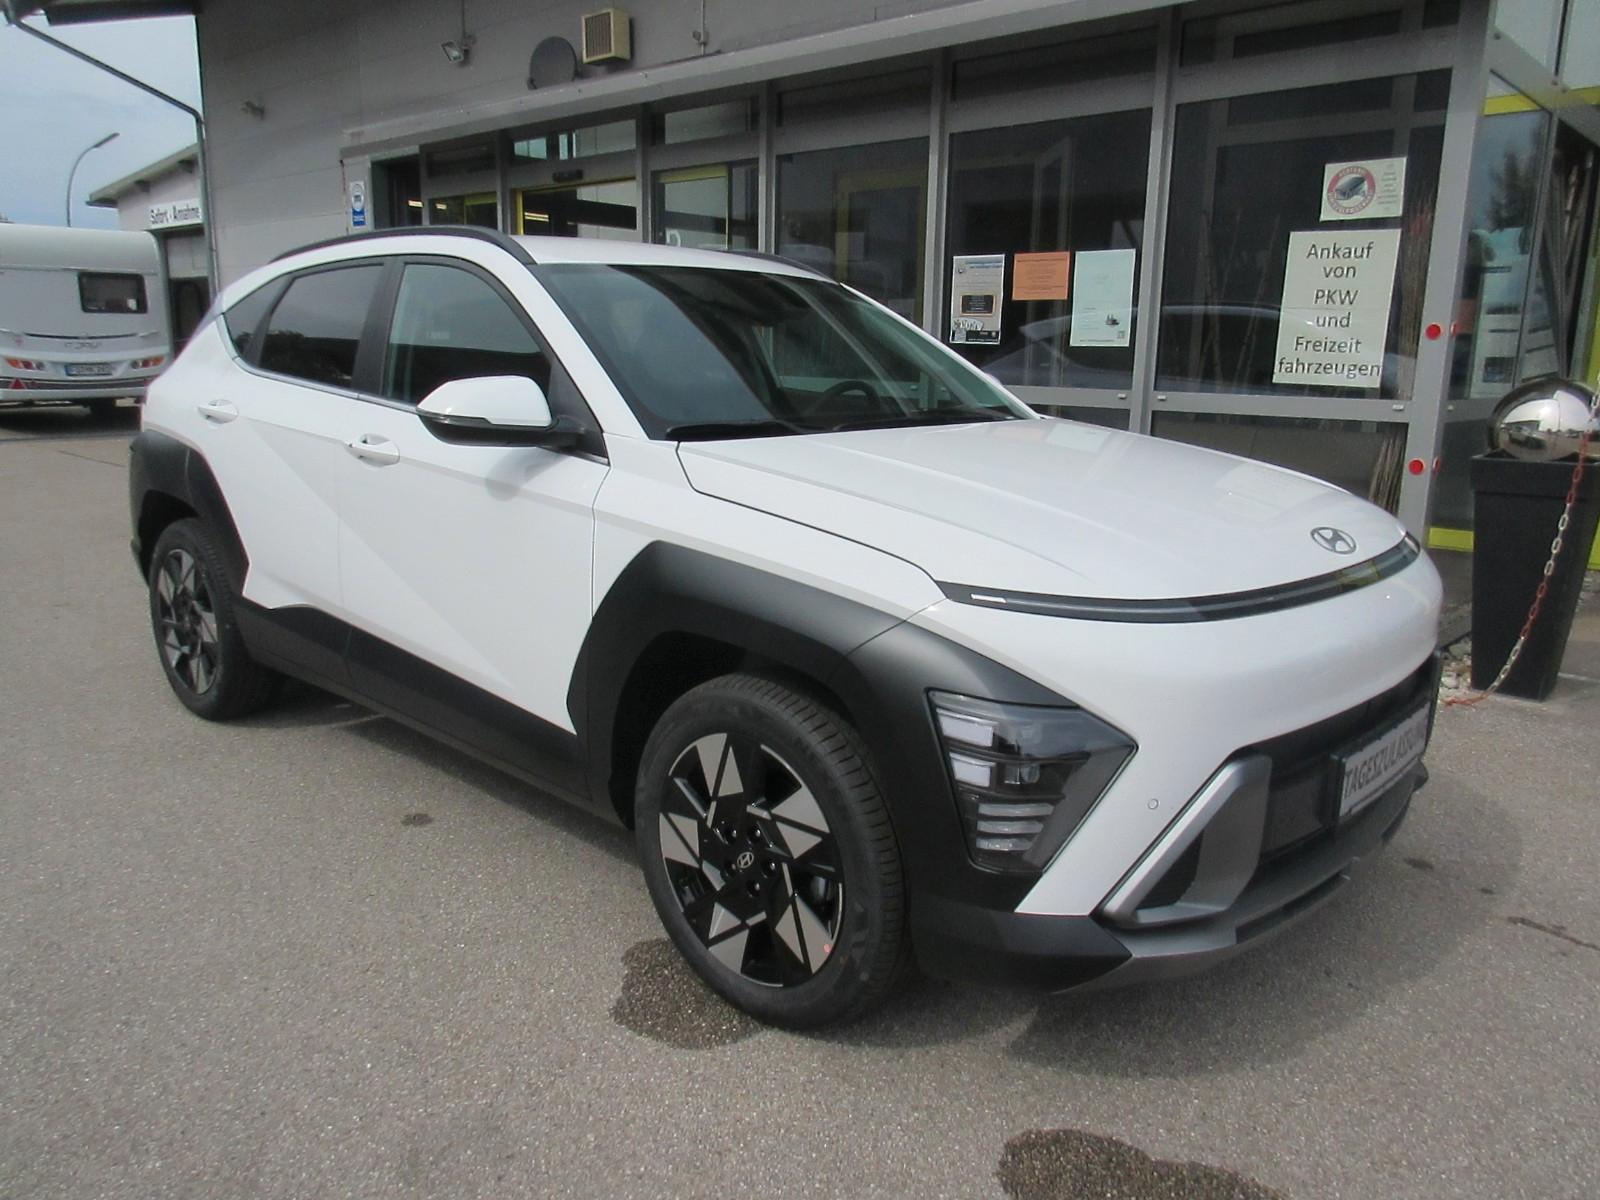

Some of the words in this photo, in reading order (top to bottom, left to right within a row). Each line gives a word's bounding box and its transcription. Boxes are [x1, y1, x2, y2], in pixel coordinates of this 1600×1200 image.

[1306, 242, 1375, 259] Ankauf
[1323, 265, 1357, 279] von
[1314, 289, 1359, 305] PKW
[1316, 312, 1351, 328] und
[1295, 336, 1362, 353] Freizeit
[1278, 357, 1380, 379] fahrzeugen
